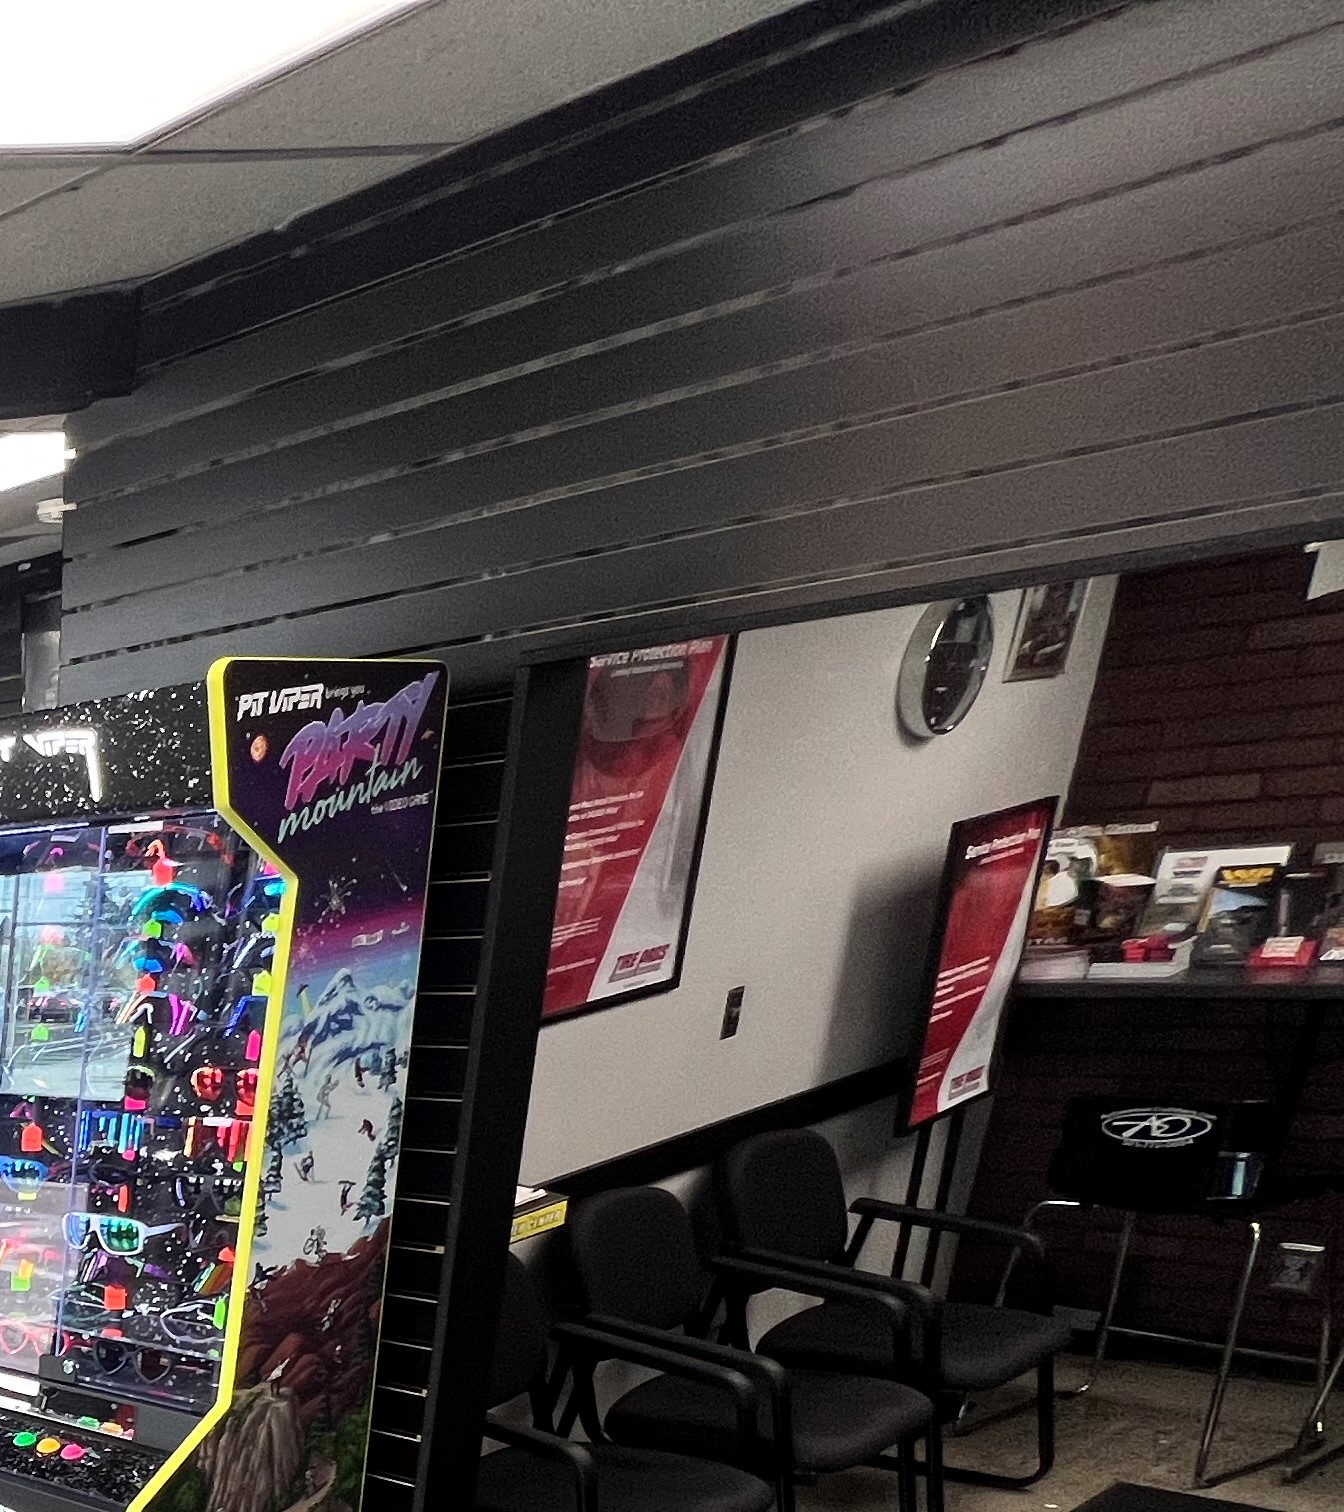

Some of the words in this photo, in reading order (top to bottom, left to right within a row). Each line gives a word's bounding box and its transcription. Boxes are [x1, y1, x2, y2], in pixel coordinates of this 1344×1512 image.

[236, 691, 268, 722] PIT
[268, 683, 325, 714] VIPER
[278, 670, 441, 811] PARTY
[22, 729, 104, 803] VIPER
[276, 743, 424, 844] mountain
